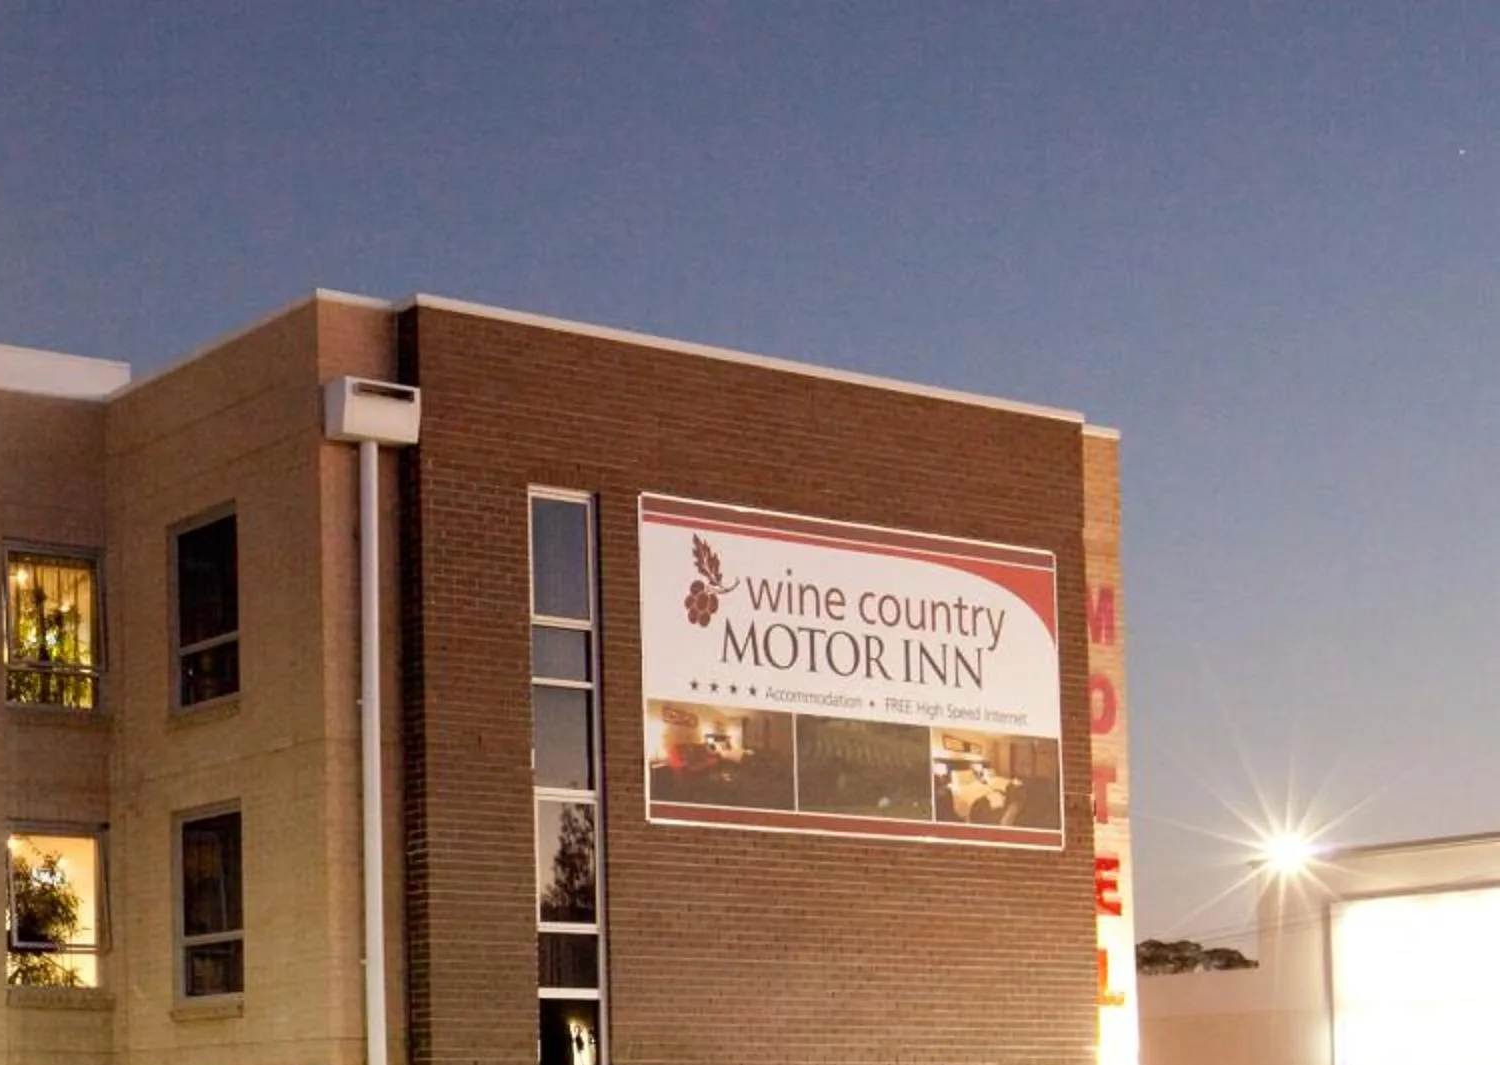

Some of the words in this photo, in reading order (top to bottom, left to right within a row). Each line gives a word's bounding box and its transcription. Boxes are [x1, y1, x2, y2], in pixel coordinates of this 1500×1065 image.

[746, 567, 846, 620] wine
[858, 589, 1005, 651] country
[720, 618, 892, 681] MOTOR
[902, 639, 984, 690] INN
[766, 686, 863, 709] Accommodation
[885, 697, 912, 715] FREE
[917, 703, 944, 720] High
[947, 703, 981, 722] Speed
